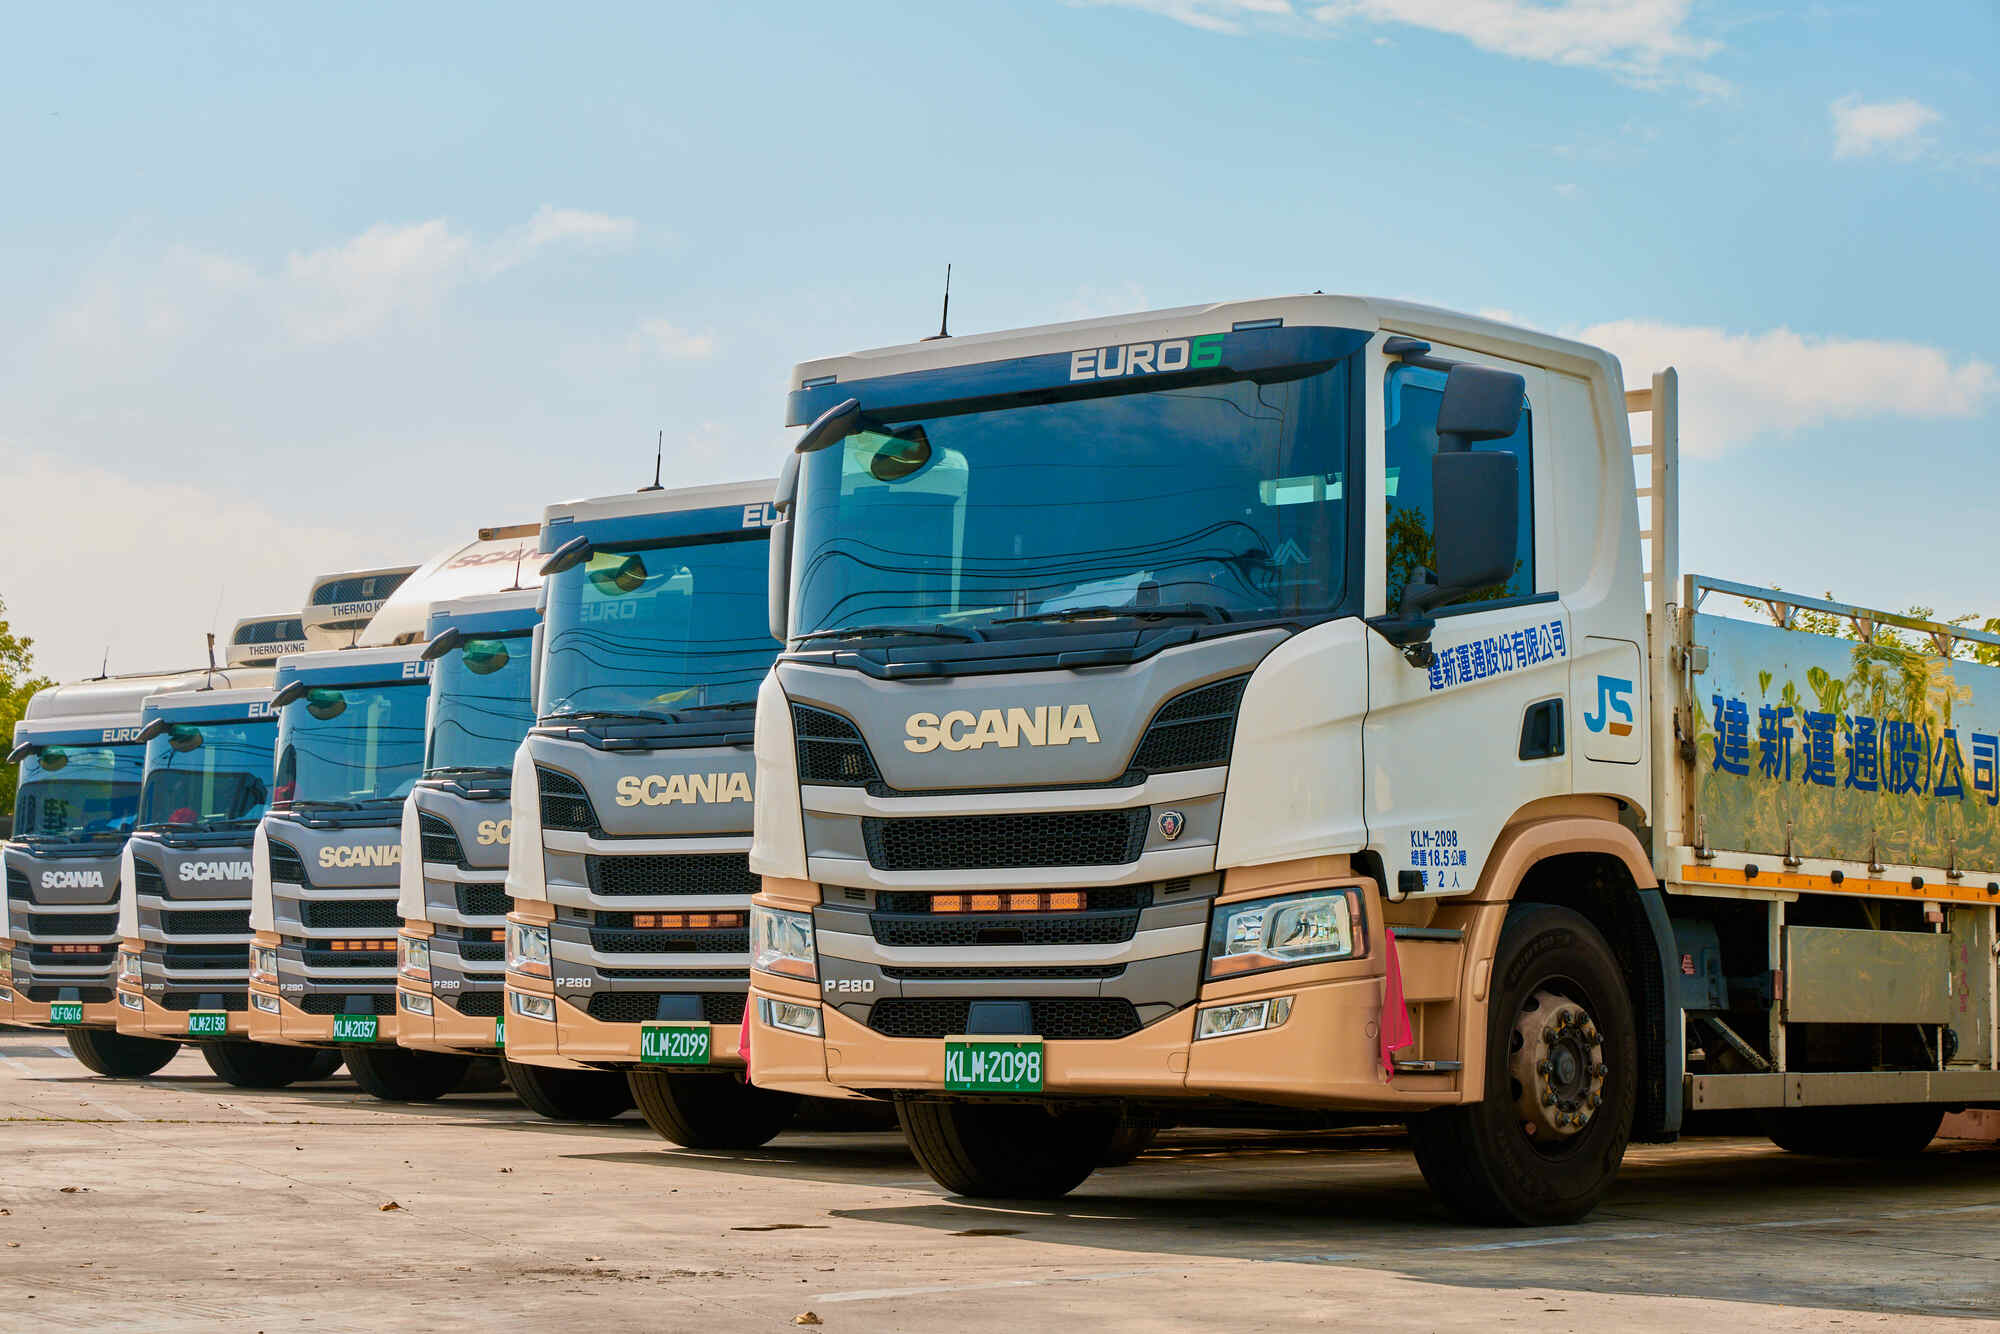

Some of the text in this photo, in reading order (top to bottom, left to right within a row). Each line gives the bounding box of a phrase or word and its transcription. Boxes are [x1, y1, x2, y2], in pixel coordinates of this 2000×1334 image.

[1069, 333, 1225, 382] EURO6
[743, 504, 788, 528] EU
[332, 602, 372, 616] THERMO
[250, 643, 305, 656] THERMO KING
[1428, 620, 1566, 691] 建新運通股份有限公司
[248, 702, 281, 717] EUR
[904, 704, 1101, 753] SCANIA
[616, 772, 753, 807] SCANIA
[1410, 830, 1458, 848] KLM-2098
[319, 845, 401, 867] SCANIA
[41, 871, 104, 889] SCANIA
[178, 861, 254, 881] SCANIA
[441, 980, 460, 989] 280
[556, 977, 592, 988] P 280
[825, 980, 874, 992] P 280
